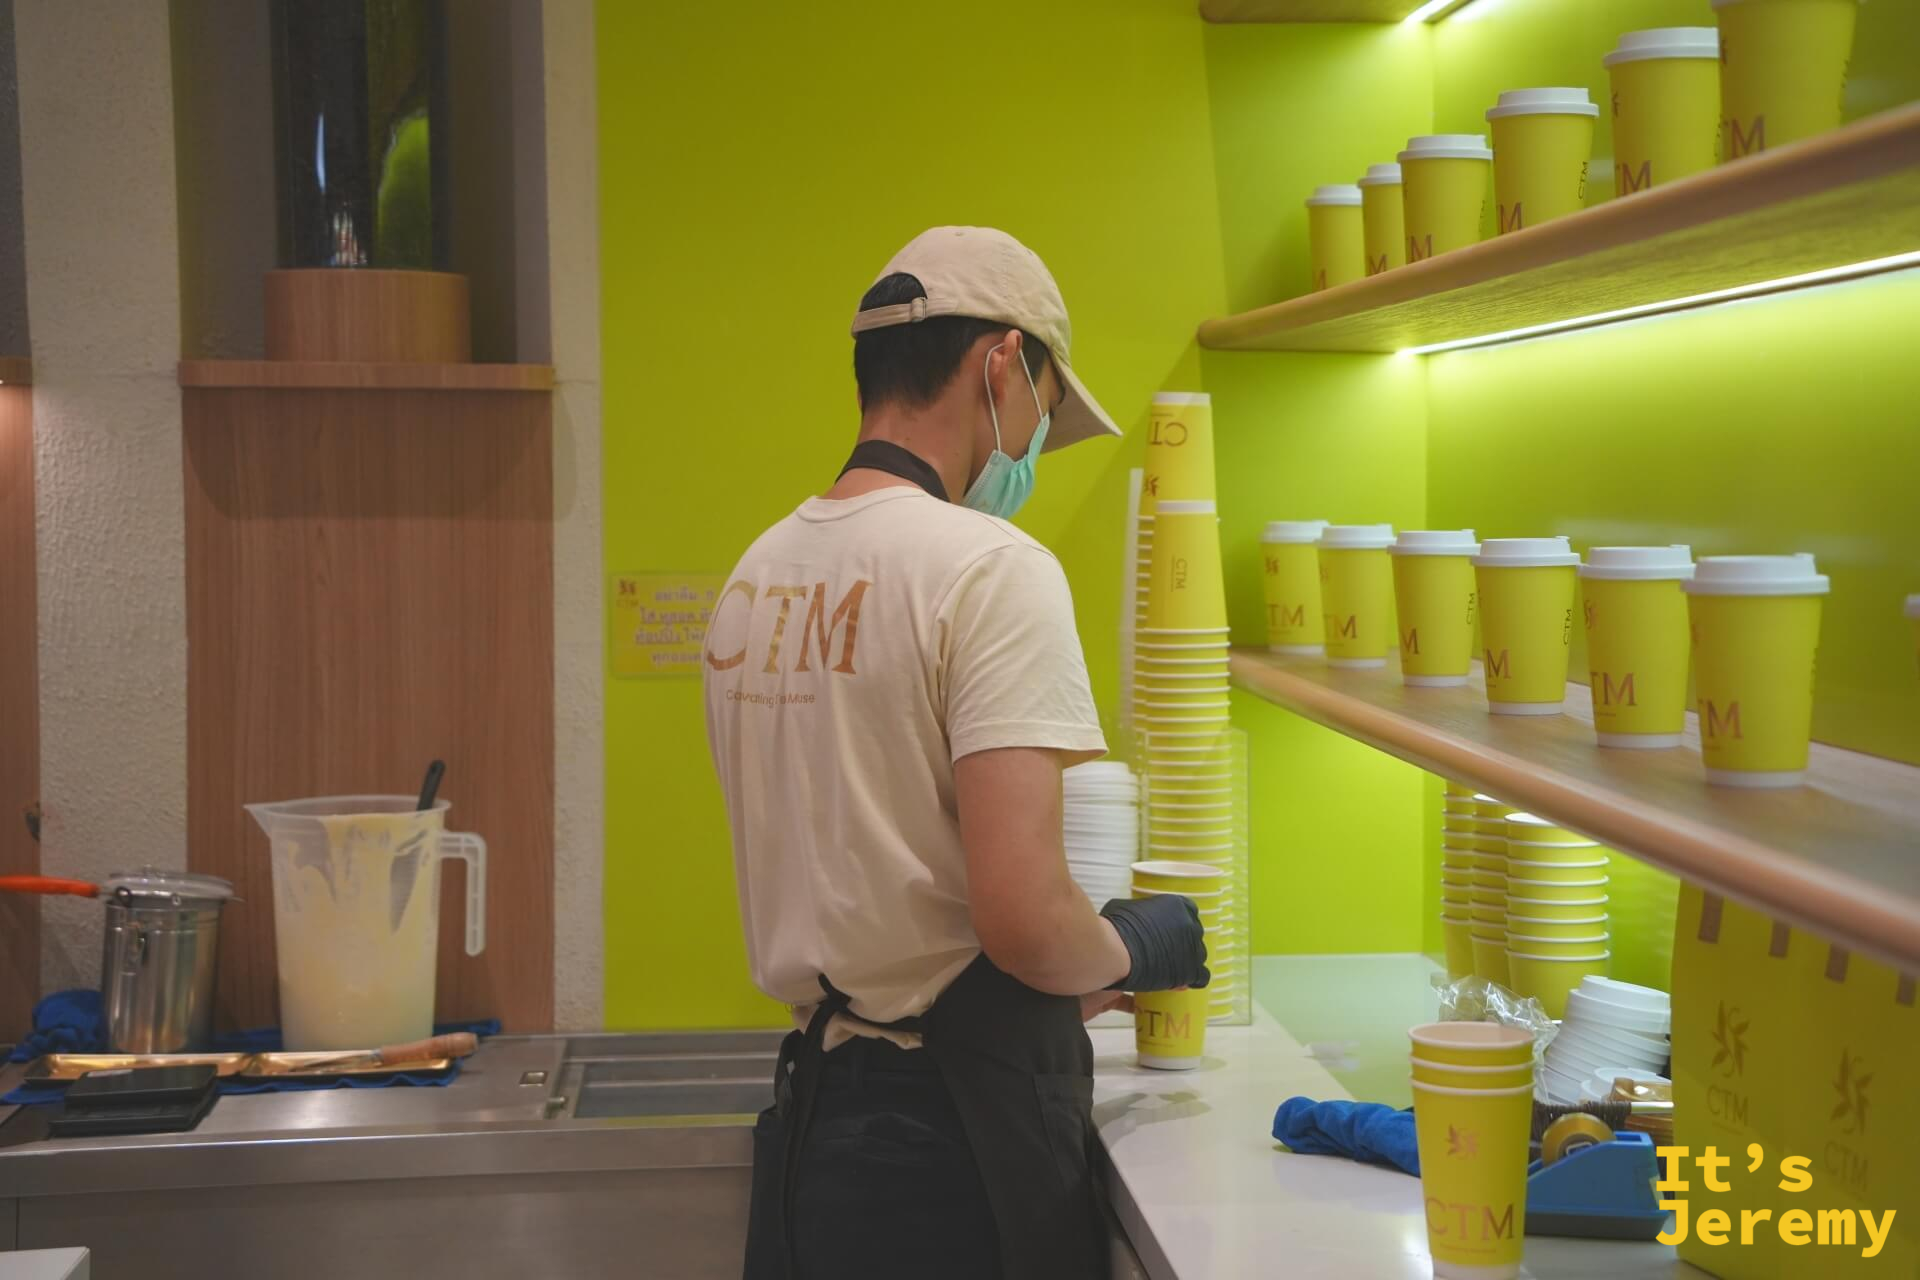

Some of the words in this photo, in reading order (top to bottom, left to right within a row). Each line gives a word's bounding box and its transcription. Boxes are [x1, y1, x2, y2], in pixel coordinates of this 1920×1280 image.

[1149, 421, 1188, 448] CT
[706, 579, 872, 675] CTM
[788, 692, 816, 705] Muse
[1706, 1084, 1749, 1128] CTM
[1425, 1196, 1515, 1241] CTM
